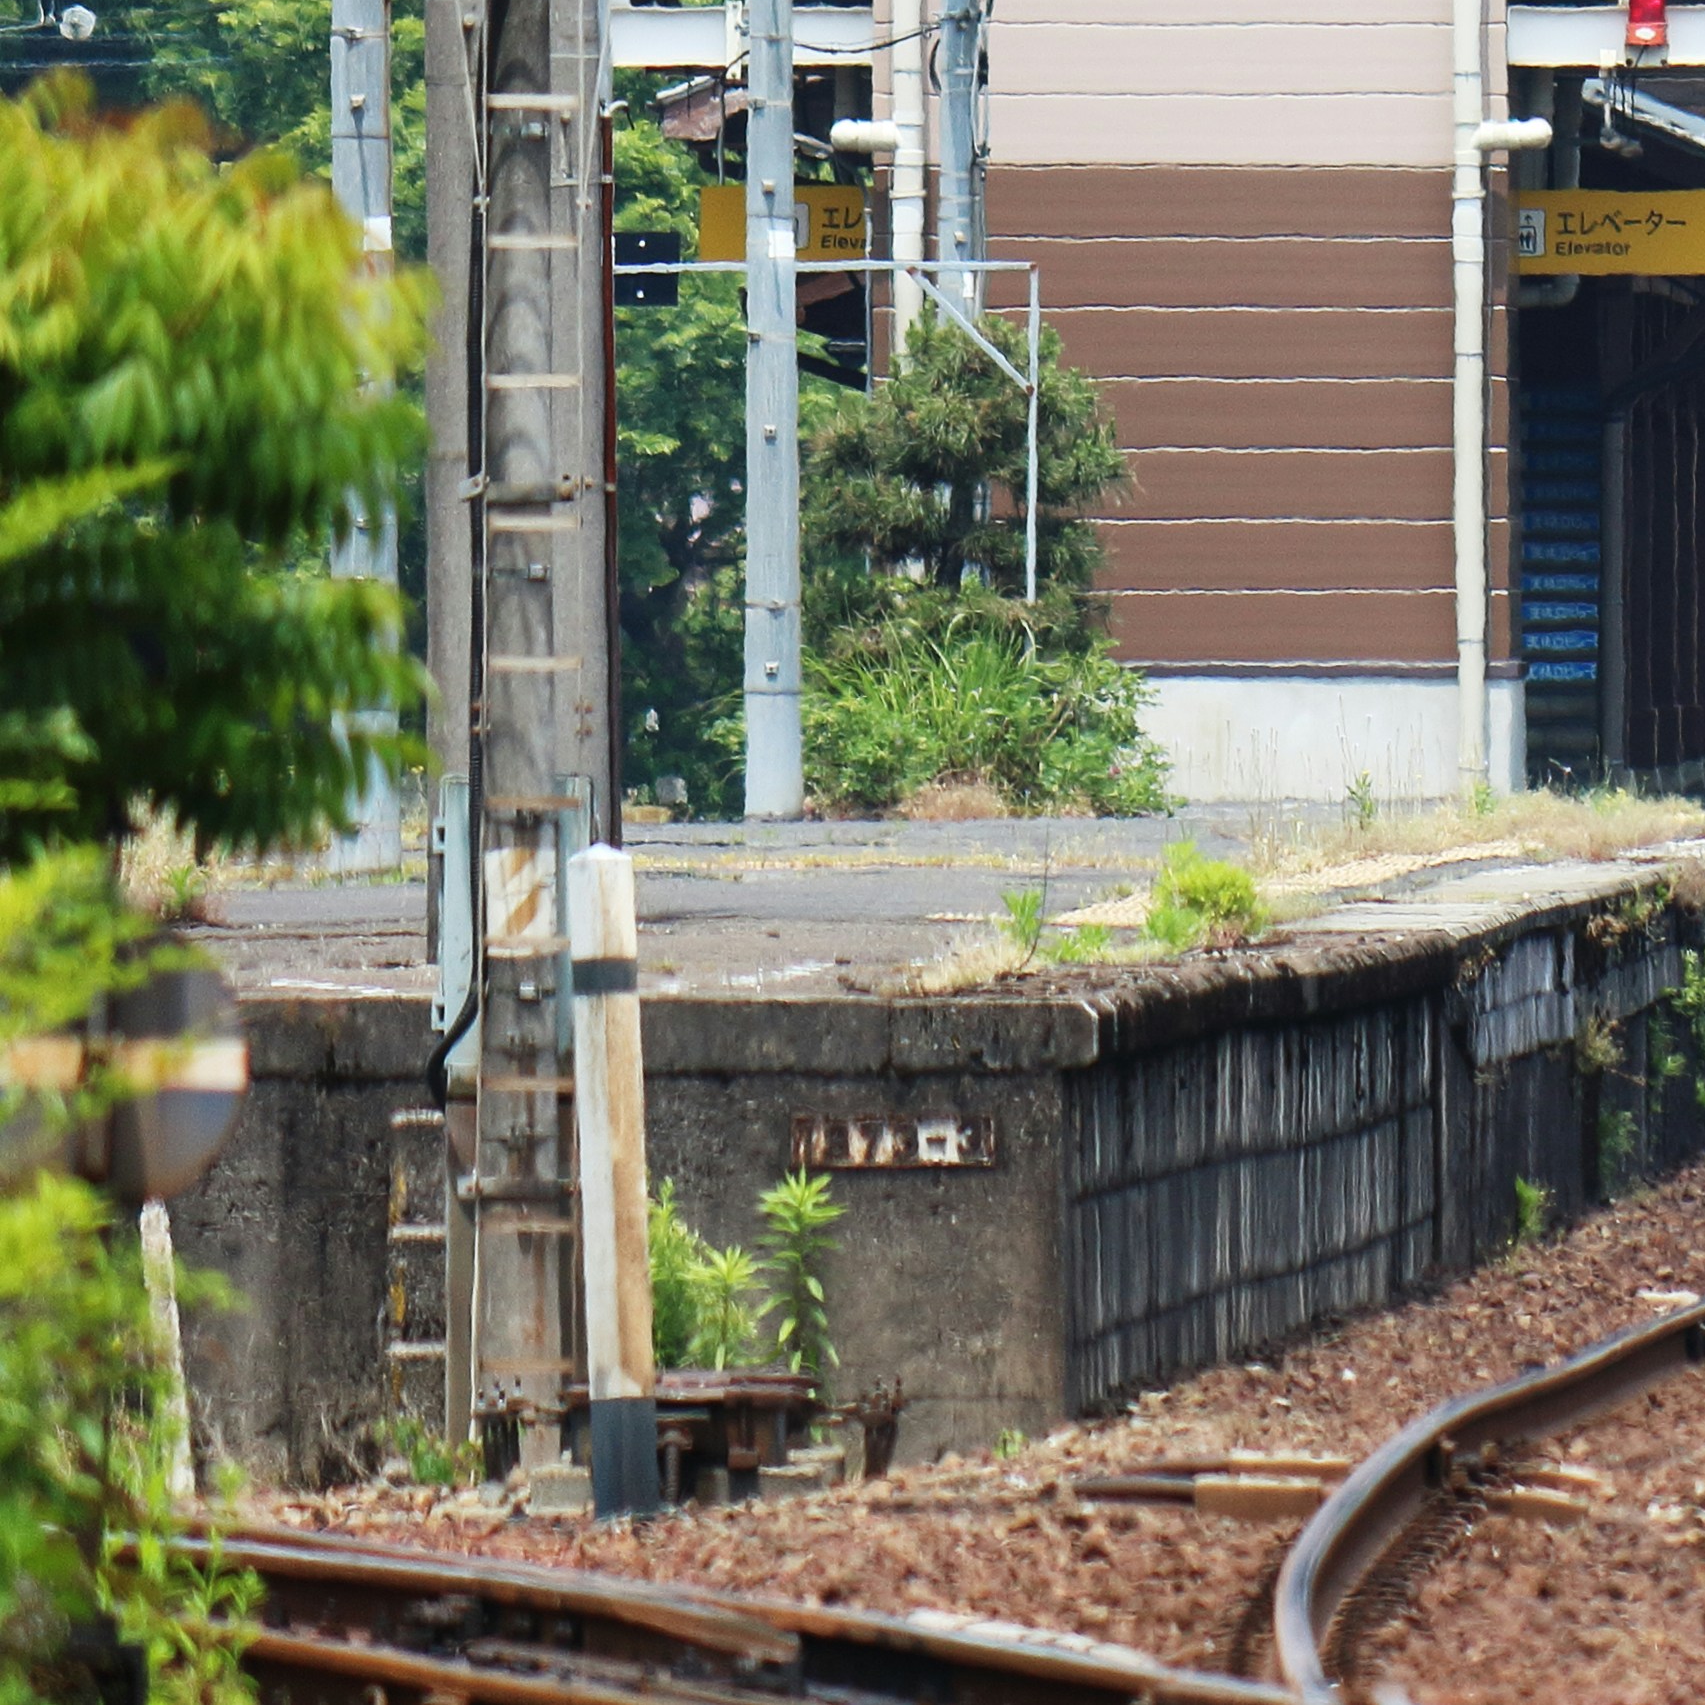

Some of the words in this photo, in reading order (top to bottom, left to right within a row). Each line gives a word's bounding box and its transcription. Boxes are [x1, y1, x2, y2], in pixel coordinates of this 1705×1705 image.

[1555, 209, 1687, 236] エレベーター
[1555, 241, 1631, 256] Elevator
